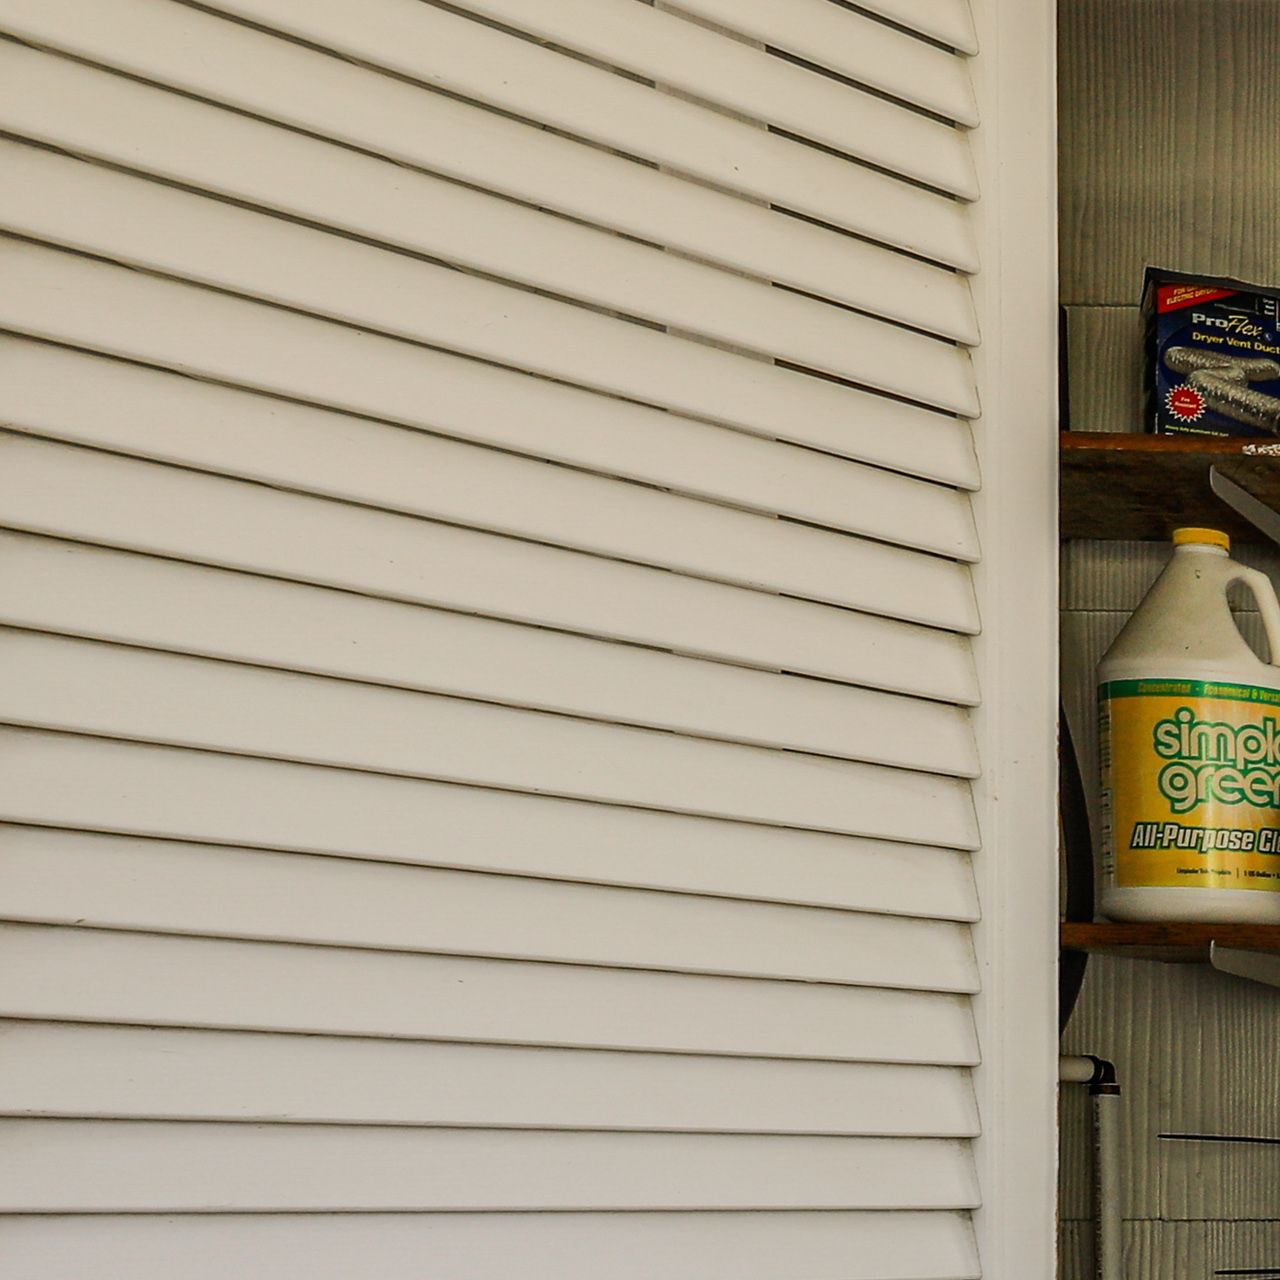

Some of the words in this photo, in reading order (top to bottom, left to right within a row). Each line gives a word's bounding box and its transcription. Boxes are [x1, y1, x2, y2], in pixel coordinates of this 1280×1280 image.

[1192, 332, 1224, 345] Dryer
[1226, 336, 1252, 350] Vent
[1254, 341, 1280, 355] Duct
[1130, 822, 1255, 854] All-Purpose
